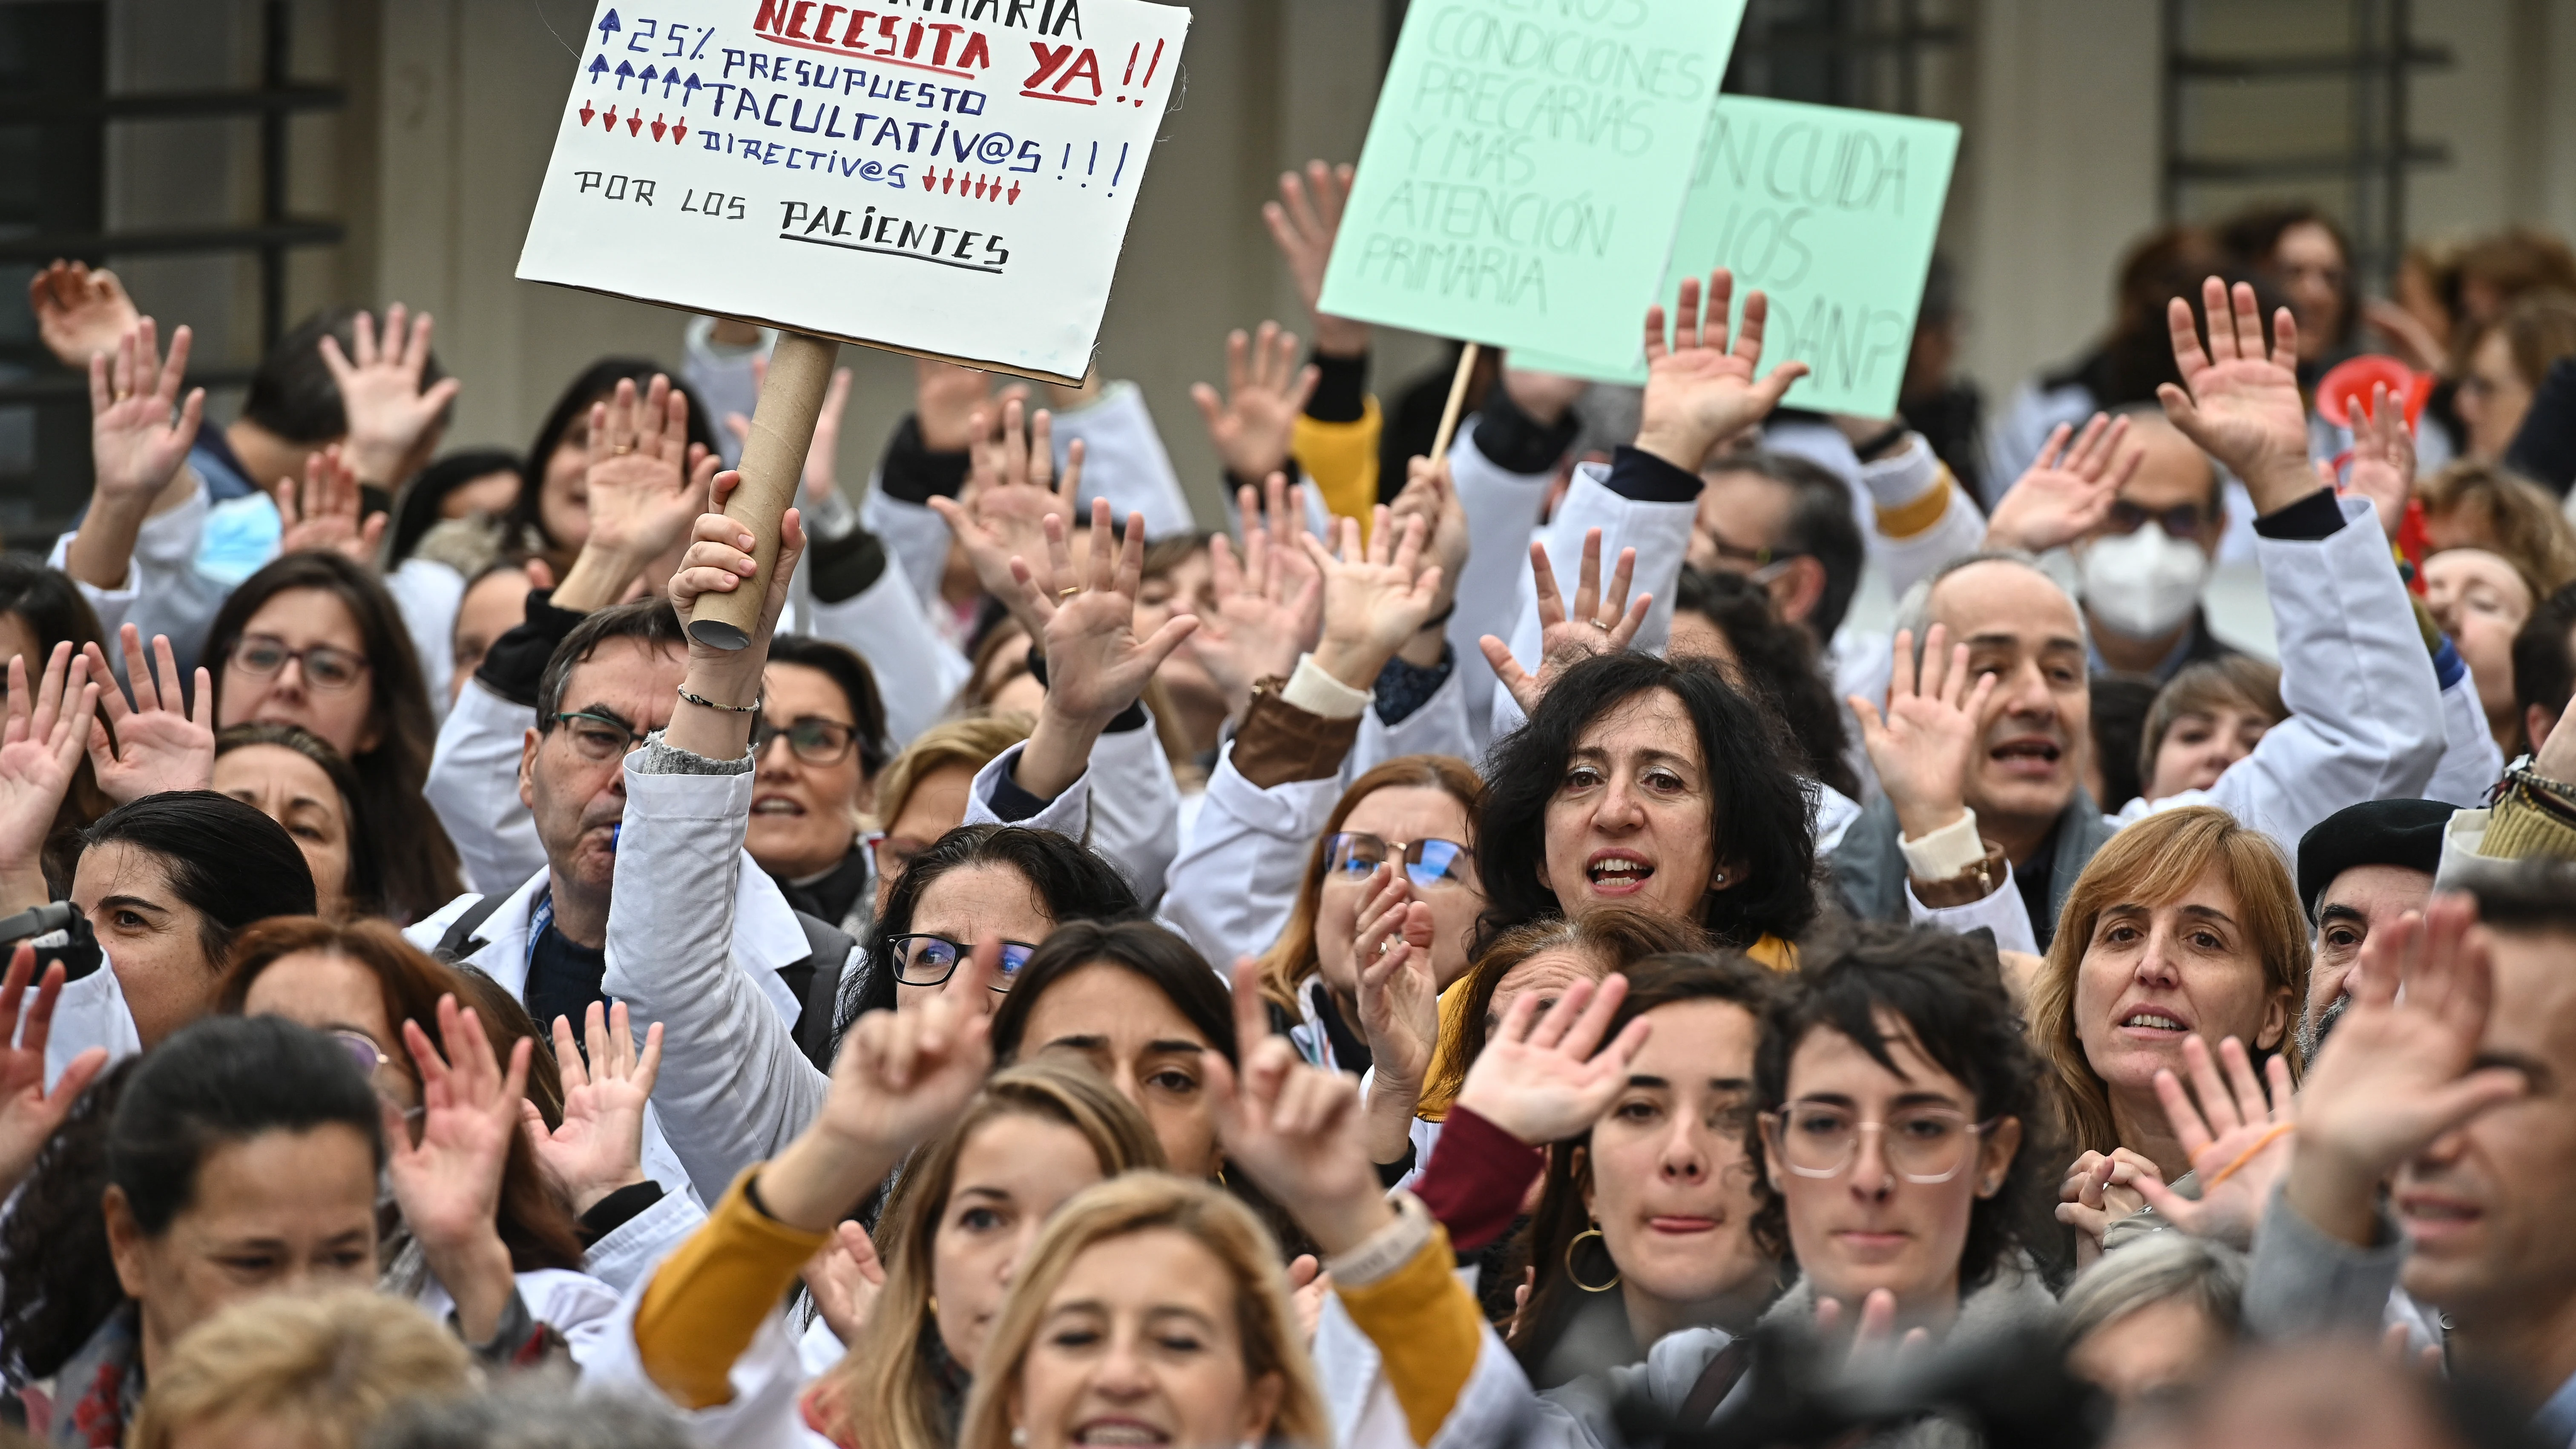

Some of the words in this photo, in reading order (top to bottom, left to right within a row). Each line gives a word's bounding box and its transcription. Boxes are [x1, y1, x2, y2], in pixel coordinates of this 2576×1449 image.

[627, 18, 715, 60] 25%
[722, 48, 986, 115] PRESUPUESTO
[1426, 5, 1706, 104] CONDICIONES
[1403, 120, 1441, 174] Y
[1410, 59, 1657, 158] PRECARIAS
[575, 172, 656, 206] POR
[681, 189, 745, 220] LOS
[1762, 120, 1910, 216] CUIDA
[1374, 177, 1617, 260] ATENCIÓN
[1355, 231, 1548, 317] PRIMARIA
